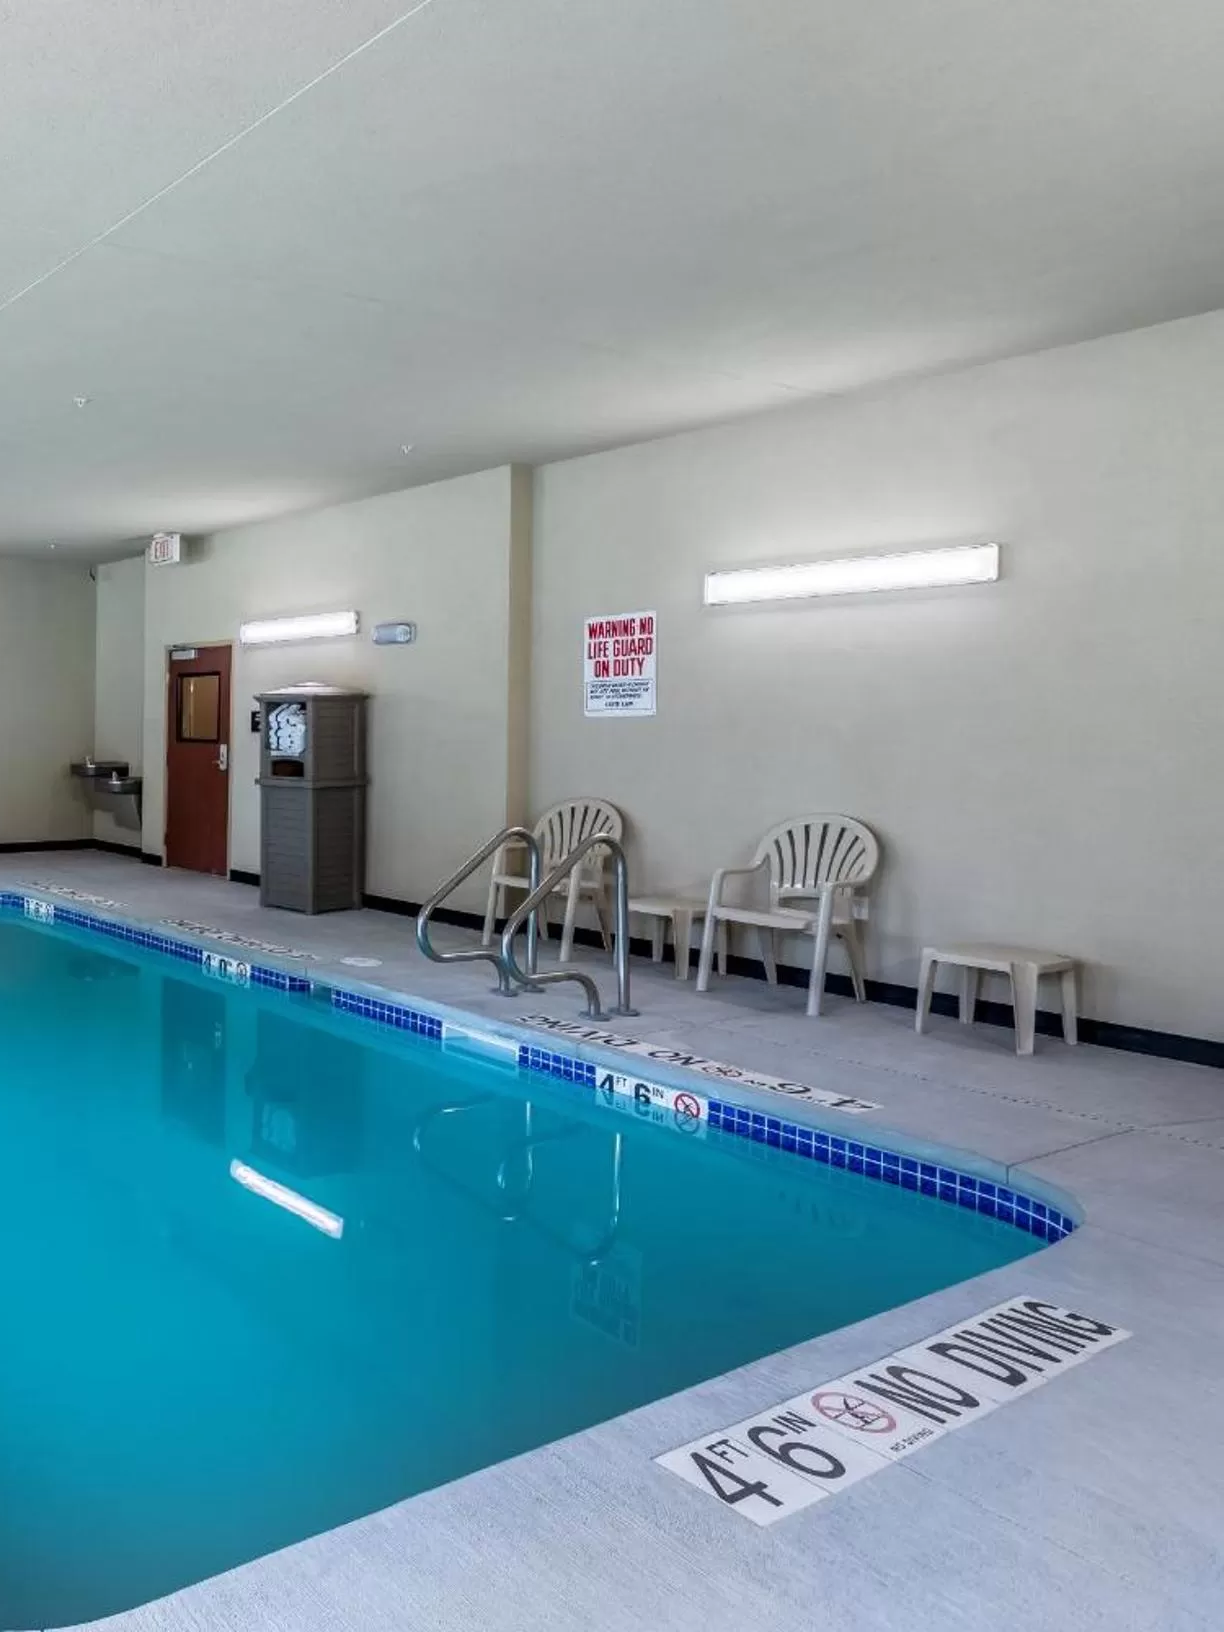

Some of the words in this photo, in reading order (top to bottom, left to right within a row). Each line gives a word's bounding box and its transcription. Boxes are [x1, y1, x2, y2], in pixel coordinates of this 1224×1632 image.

[588, 618, 636, 639] WARNING
[639, 616, 654, 635] NO
[588, 641, 609, 660] LIFE
[613, 637, 654, 657] GUARD
[594, 660, 610, 678] ON
[613, 657, 645, 677] DUTY
[853, 1365, 980, 1425] NO
[926, 1301, 1119, 1388] DIVING
